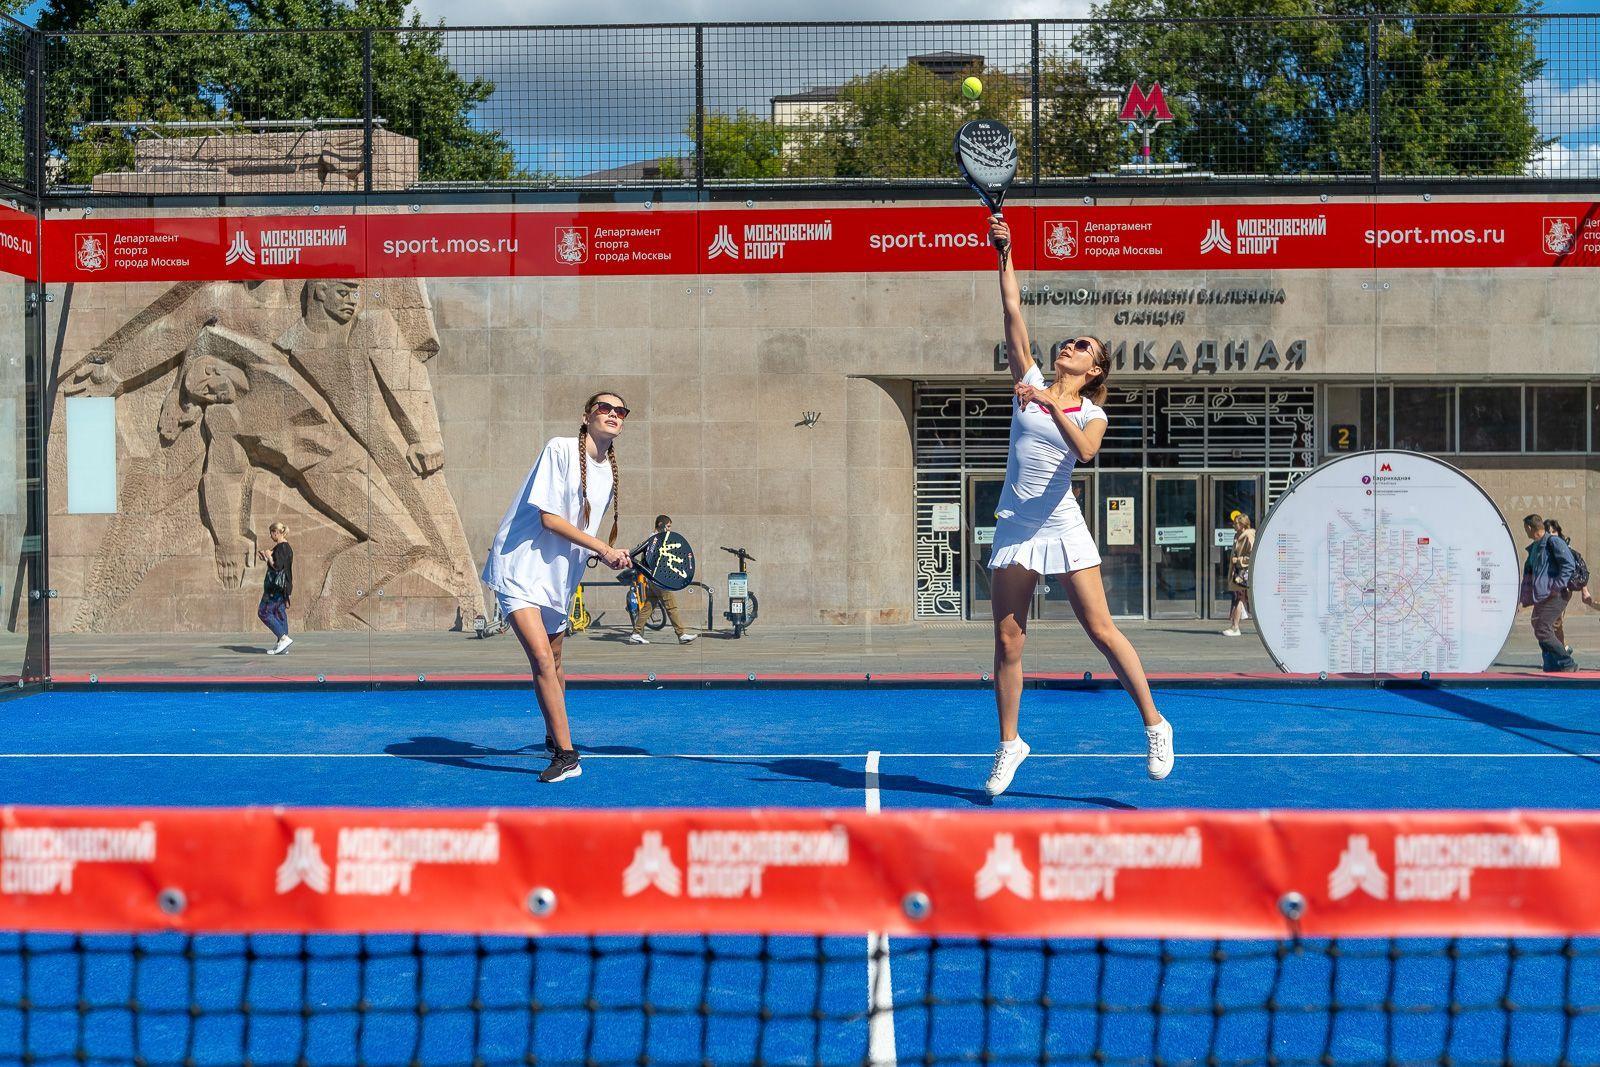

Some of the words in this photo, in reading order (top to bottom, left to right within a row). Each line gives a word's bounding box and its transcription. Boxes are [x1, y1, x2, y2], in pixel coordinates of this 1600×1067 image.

[594, 227, 662, 238] Департамент
[744, 220, 832, 241] МОСКОВСКИЙ
[1084, 222, 1153, 233] Департамент
[1236, 215, 1327, 236] МОСКОВСКИЙ
[114, 233, 180, 244] Департамент
[260, 226, 347, 247] МОСКОВСКИЙ
[594, 239, 630, 250] спорта
[869, 231, 991, 252] sport.mos.
[1084, 234, 1121, 245] спорта
[1364, 227, 1505, 248] sport.mos.ru
[114, 246, 149, 257] спорта
[383, 236, 519, 257] sport.mos.ru
[744, 242, 786, 260] СПОРТ
[1084, 246, 1122, 257] города
[1122, 245, 1164, 256] Москвы
[1236, 237, 1280, 255] СПОРТ
[114, 257, 149, 268] города
[151, 257, 190, 267] Москвы
[260, 247, 302, 265] СПОРТ
[594, 251, 631, 262] города
[632, 251, 672, 261] Москвы
[1113, 310, 1185, 327] СТАНЦИЯ
[1338, 428, 1350, 444] 2
[0, 862, 75, 894] СПОРТ
[336, 862, 415, 894] СПОРТ
[687, 866, 763, 897] СПОРТ
[1040, 869, 1117, 900] СПОРТ
[1395, 868, 1473, 900] СПОРТ
